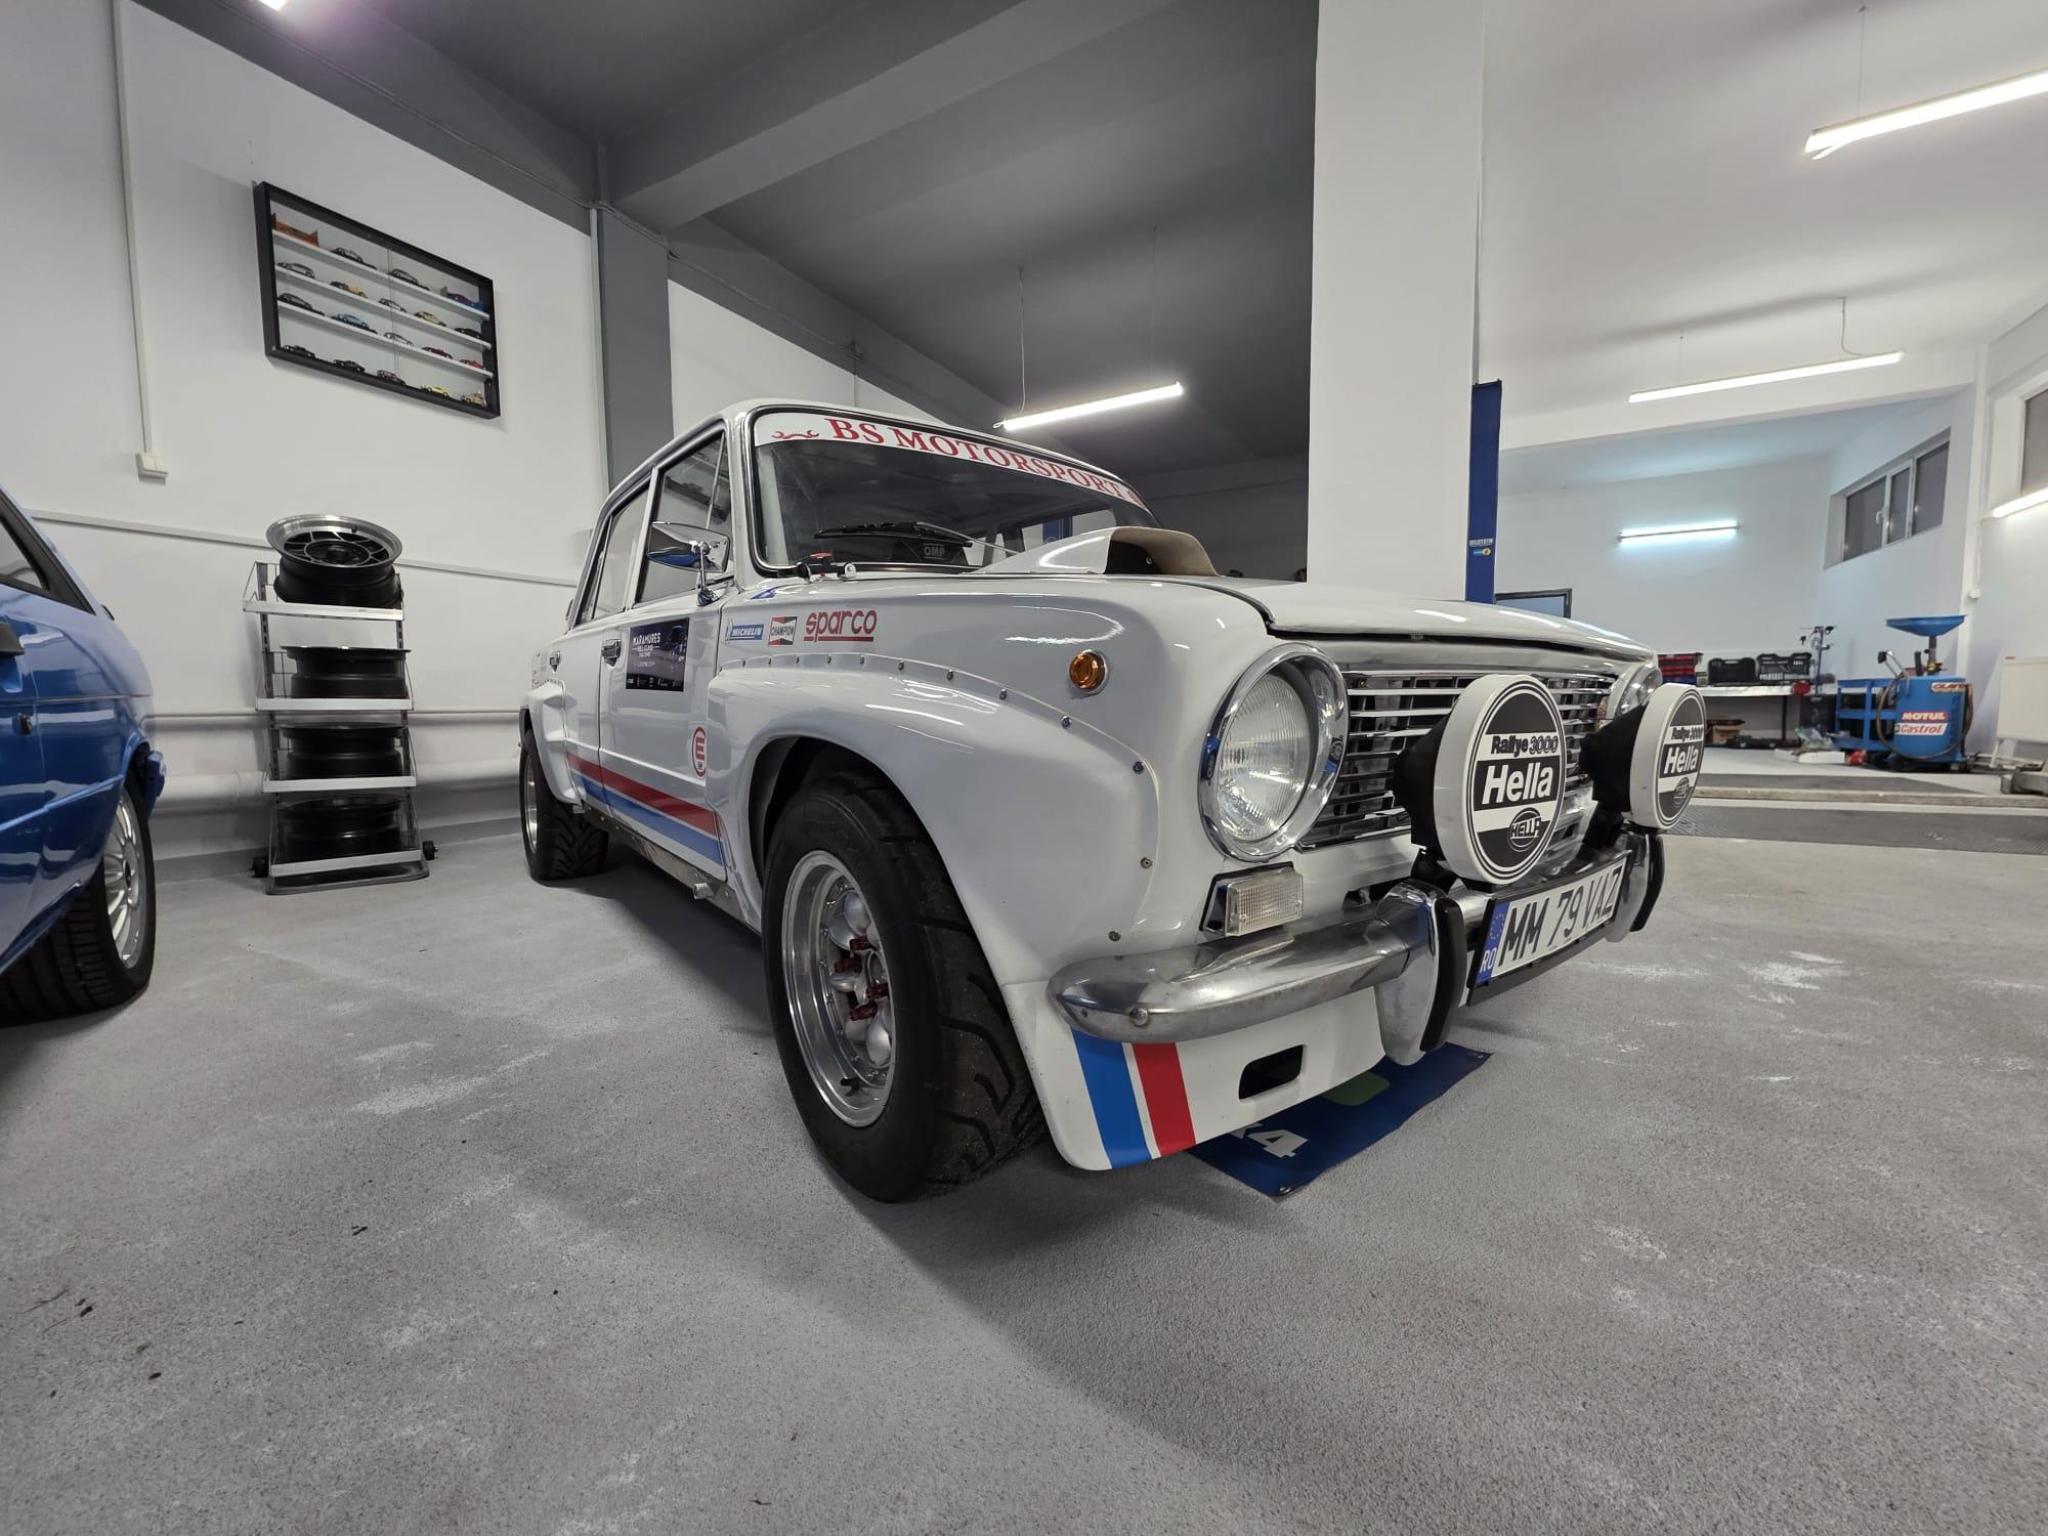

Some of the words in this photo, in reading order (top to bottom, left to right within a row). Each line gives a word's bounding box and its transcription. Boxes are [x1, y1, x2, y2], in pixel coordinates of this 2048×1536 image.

[825, 418, 885, 443] BS
[889, 427, 1120, 498] MOTORSPORT
[732, 626, 763, 637] MICHELIN
[771, 624, 794, 637] CHAMPION
[806, 609, 877, 642] sparco
[1900, 725, 1943, 734] Castrol
[1902, 712, 1946, 720] MOTUL
[1491, 735, 1529, 758] Rallye
[1528, 735, 1559, 755] 3000
[1663, 745, 1699, 774] Hella
[1481, 762, 1554, 805] Hella
[1498, 898, 1550, 968] MM
[1547, 885, 1584, 948] 79
[1582, 865, 1623, 929] VAZ
[1479, 947, 1498, 974] RO
